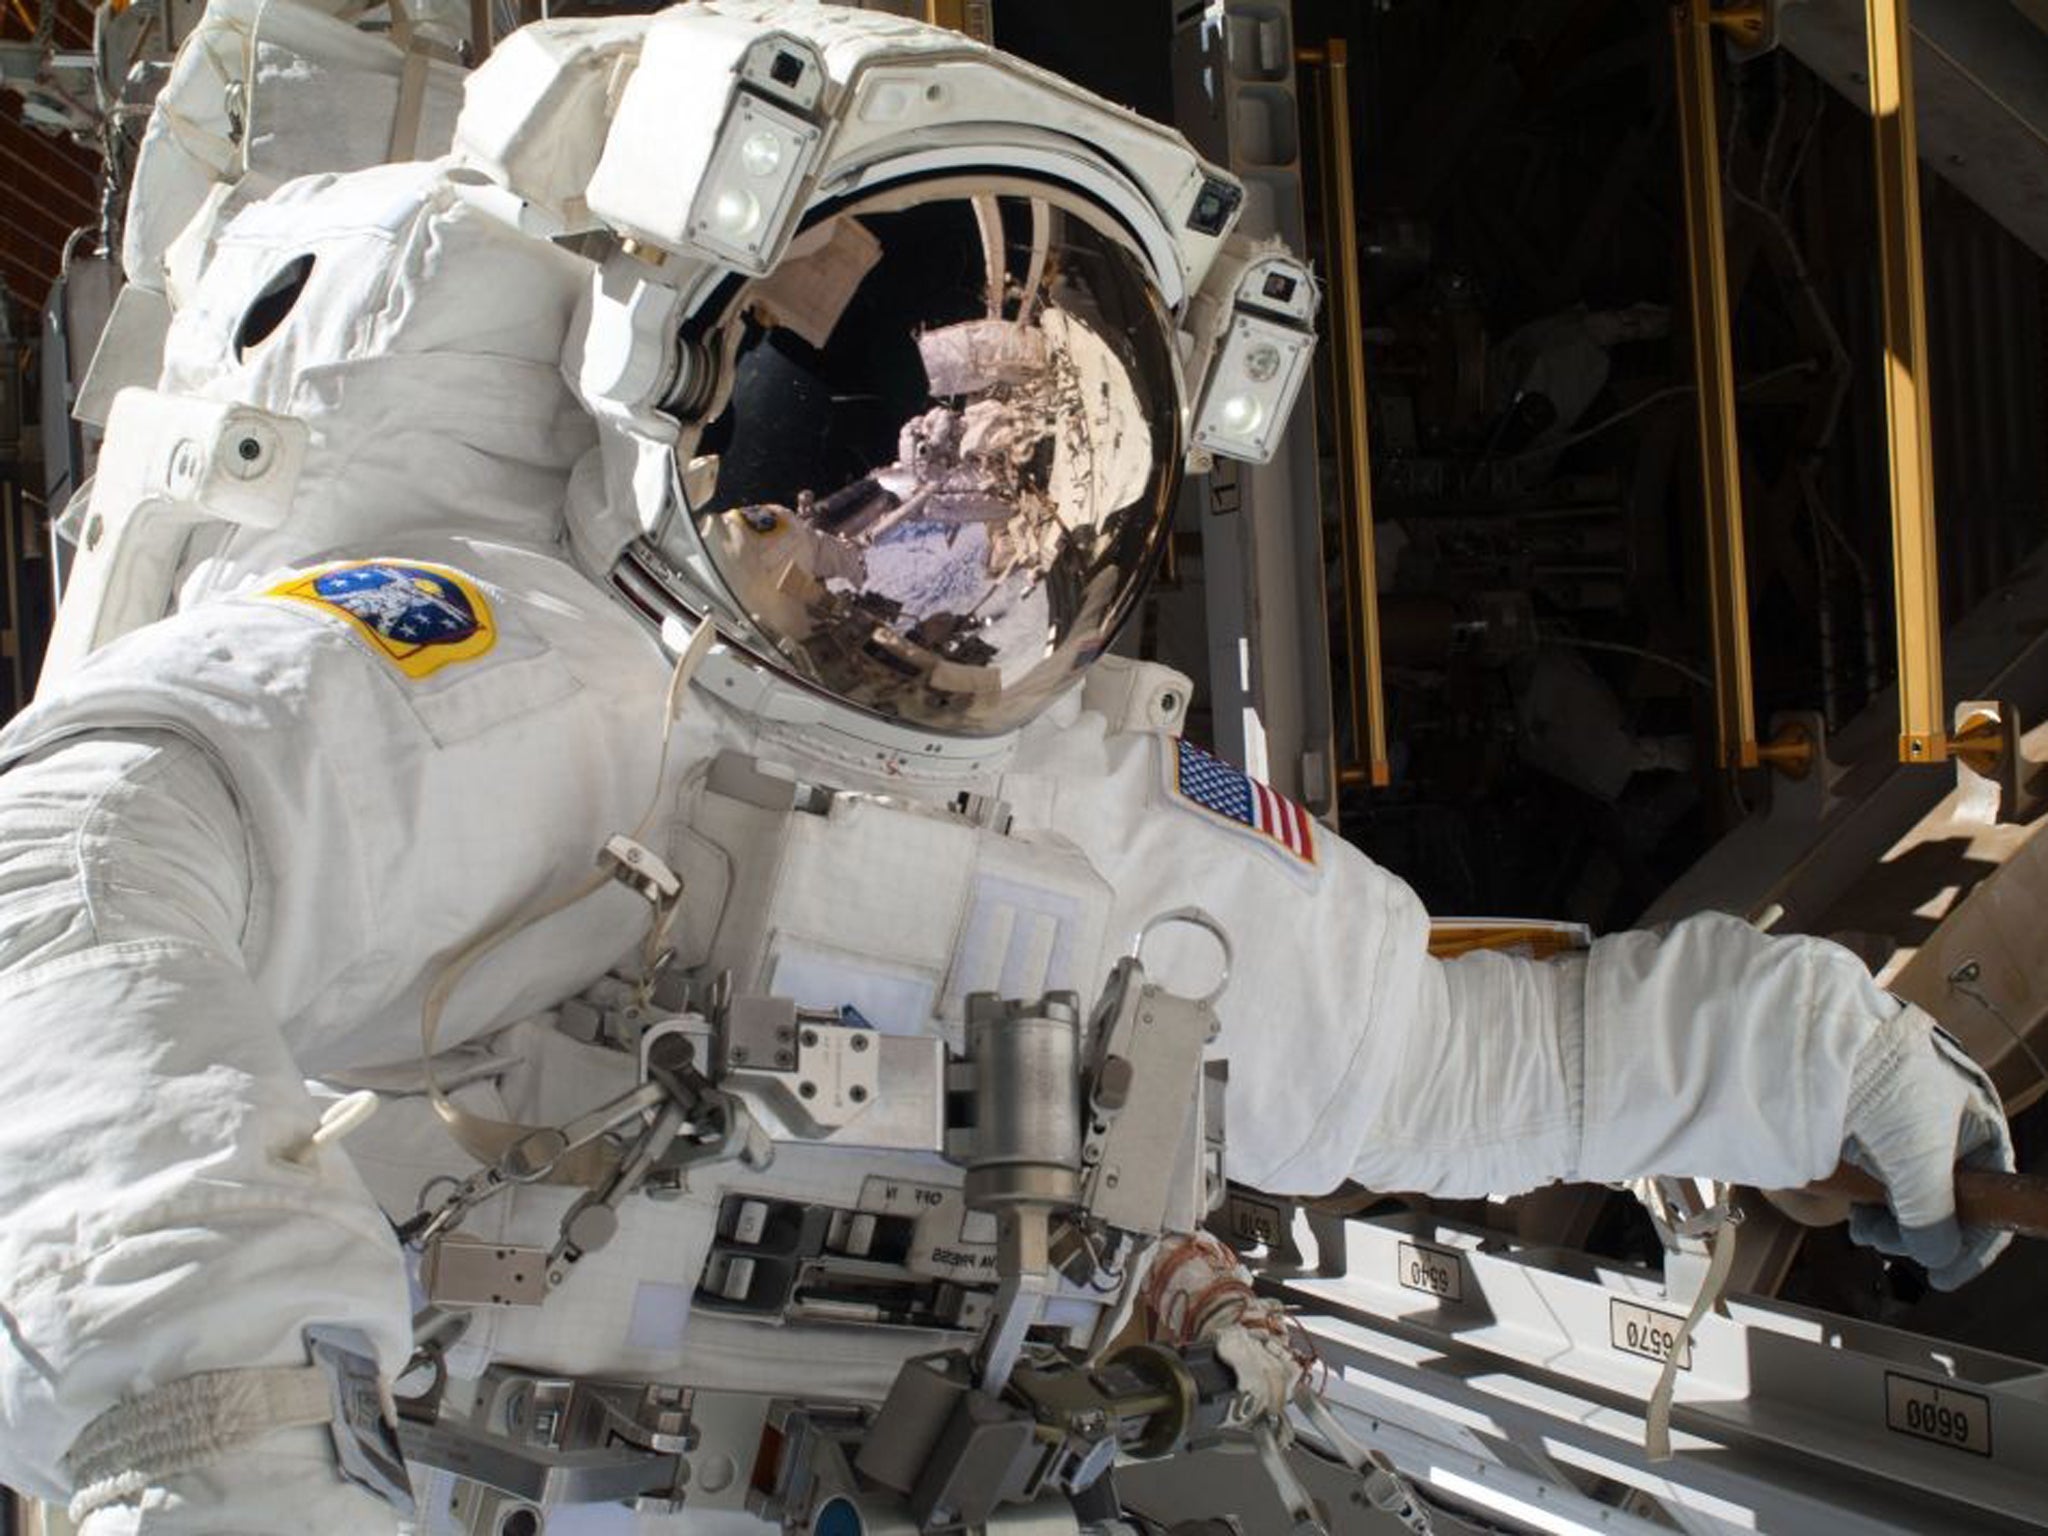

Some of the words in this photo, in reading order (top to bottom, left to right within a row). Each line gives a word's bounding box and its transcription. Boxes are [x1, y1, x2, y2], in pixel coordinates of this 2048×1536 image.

[1411, 1261, 1449, 1293] 6540
[1626, 1321, 1674, 1359] 6570
[1906, 1398, 1969, 1443] 6600
